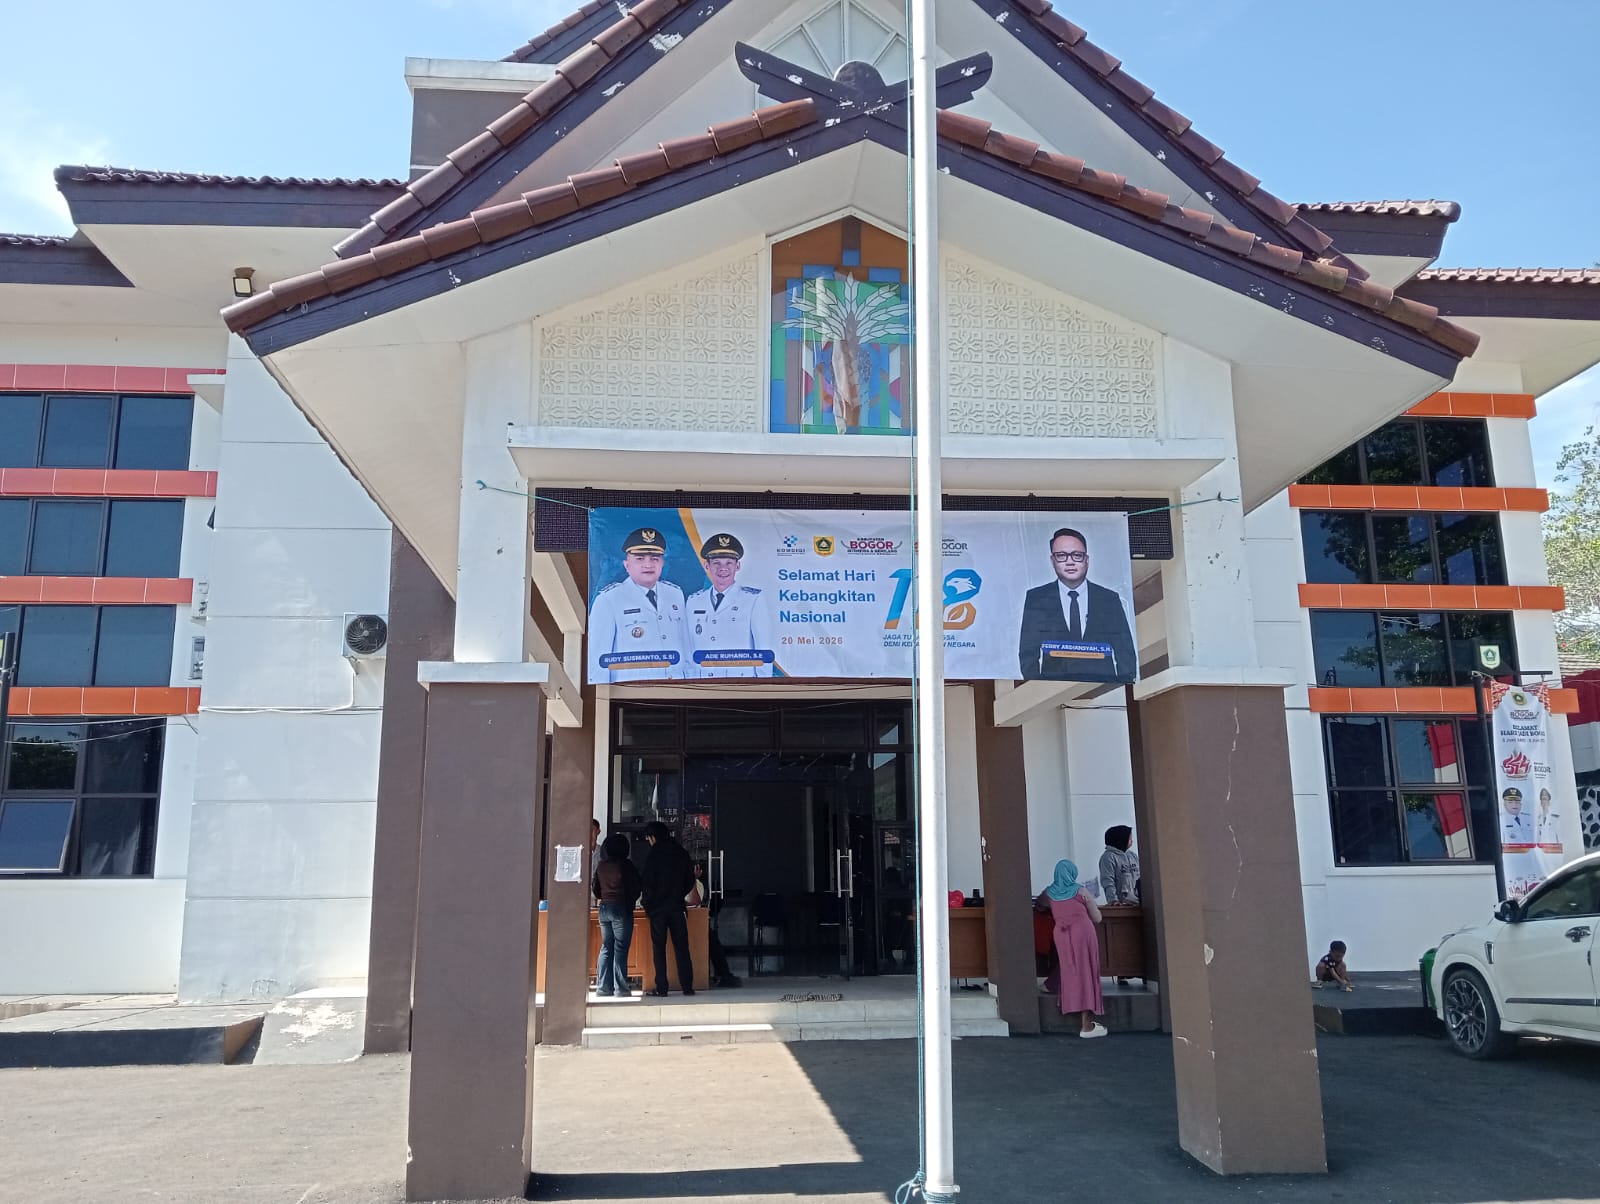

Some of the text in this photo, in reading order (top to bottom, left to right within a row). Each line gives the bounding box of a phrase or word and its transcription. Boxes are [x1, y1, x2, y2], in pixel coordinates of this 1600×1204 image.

[850, 540, 894, 549] BOGOR
[941, 542, 968, 550] OGOR
[778, 569, 876, 581] Selamat Hari
[779, 589, 876, 604] Kebangkitan
[779, 610, 846, 623] Nasional
[781, 636, 843, 645] 20 Mei 2026
